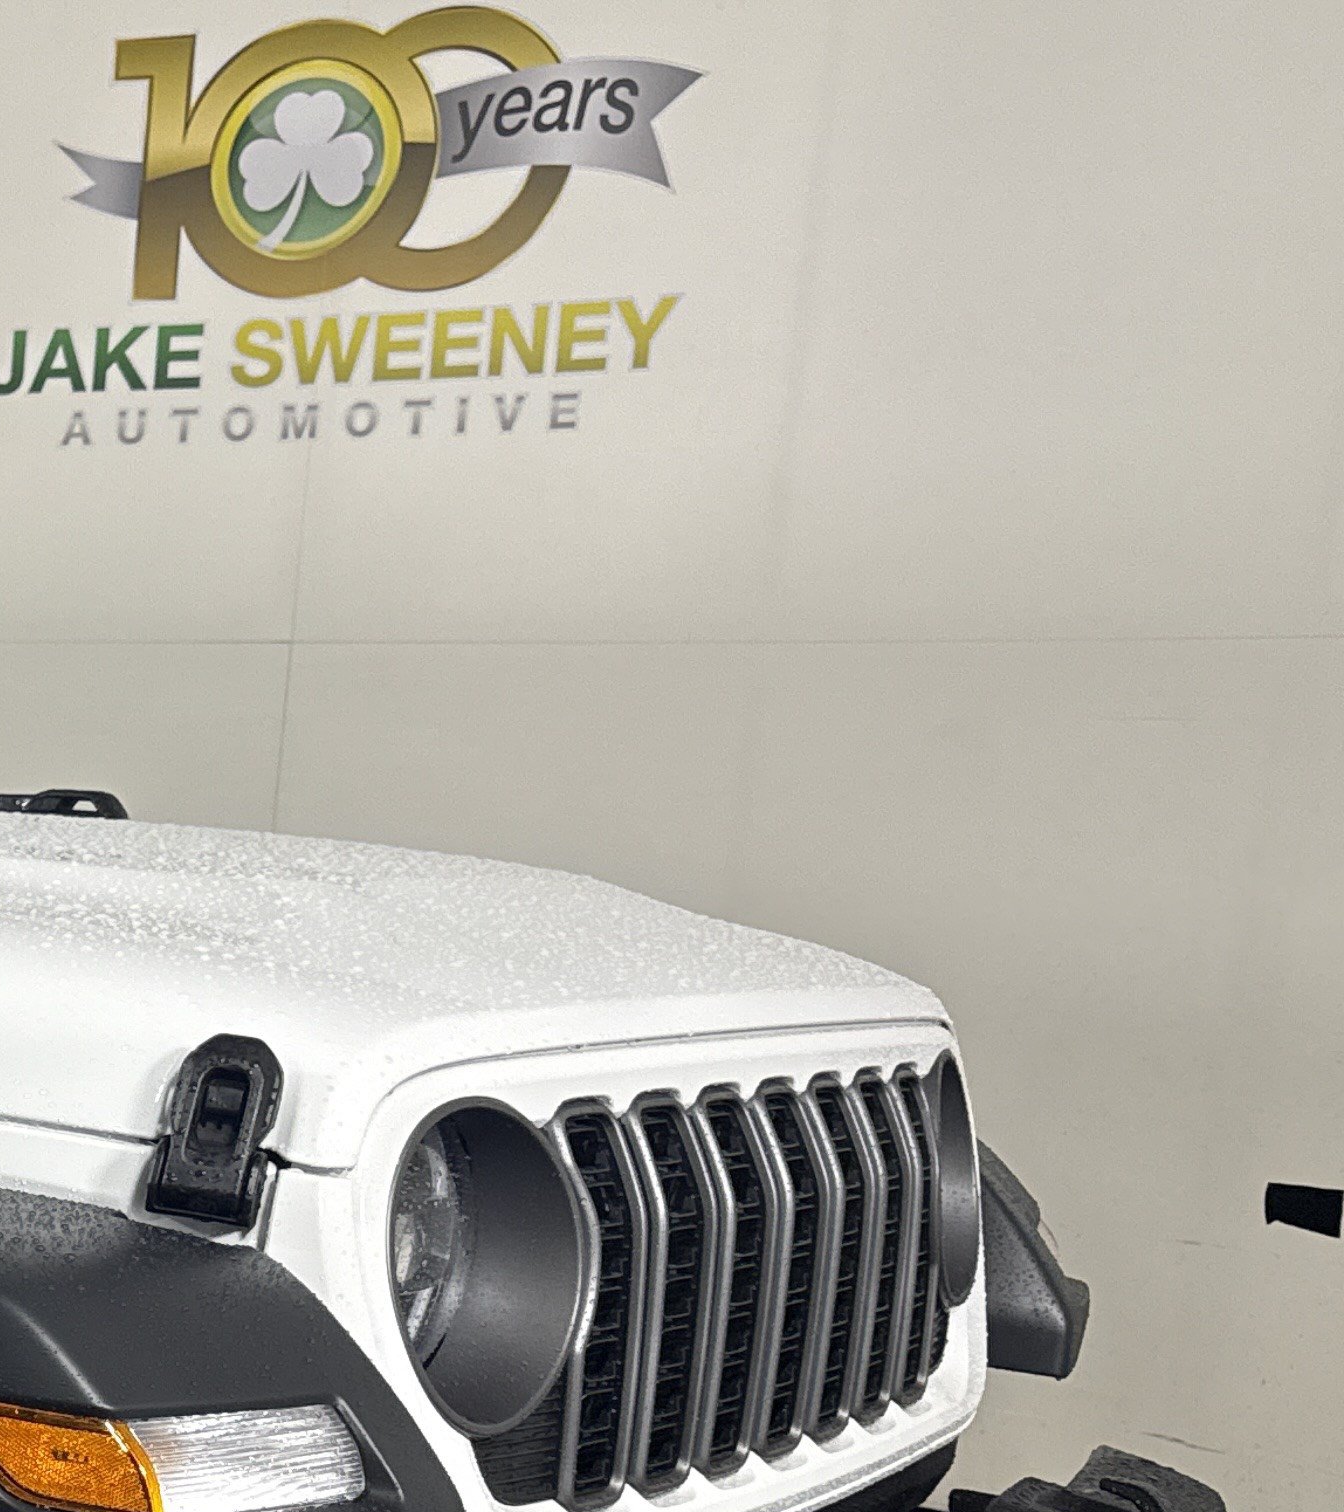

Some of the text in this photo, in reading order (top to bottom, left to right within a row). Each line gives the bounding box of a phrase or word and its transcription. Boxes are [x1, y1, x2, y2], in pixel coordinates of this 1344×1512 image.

[452, 74, 640, 161] years
[230, 295, 679, 388] SWEENEY
[61, 393, 580, 446] AUTOMOTIVE
